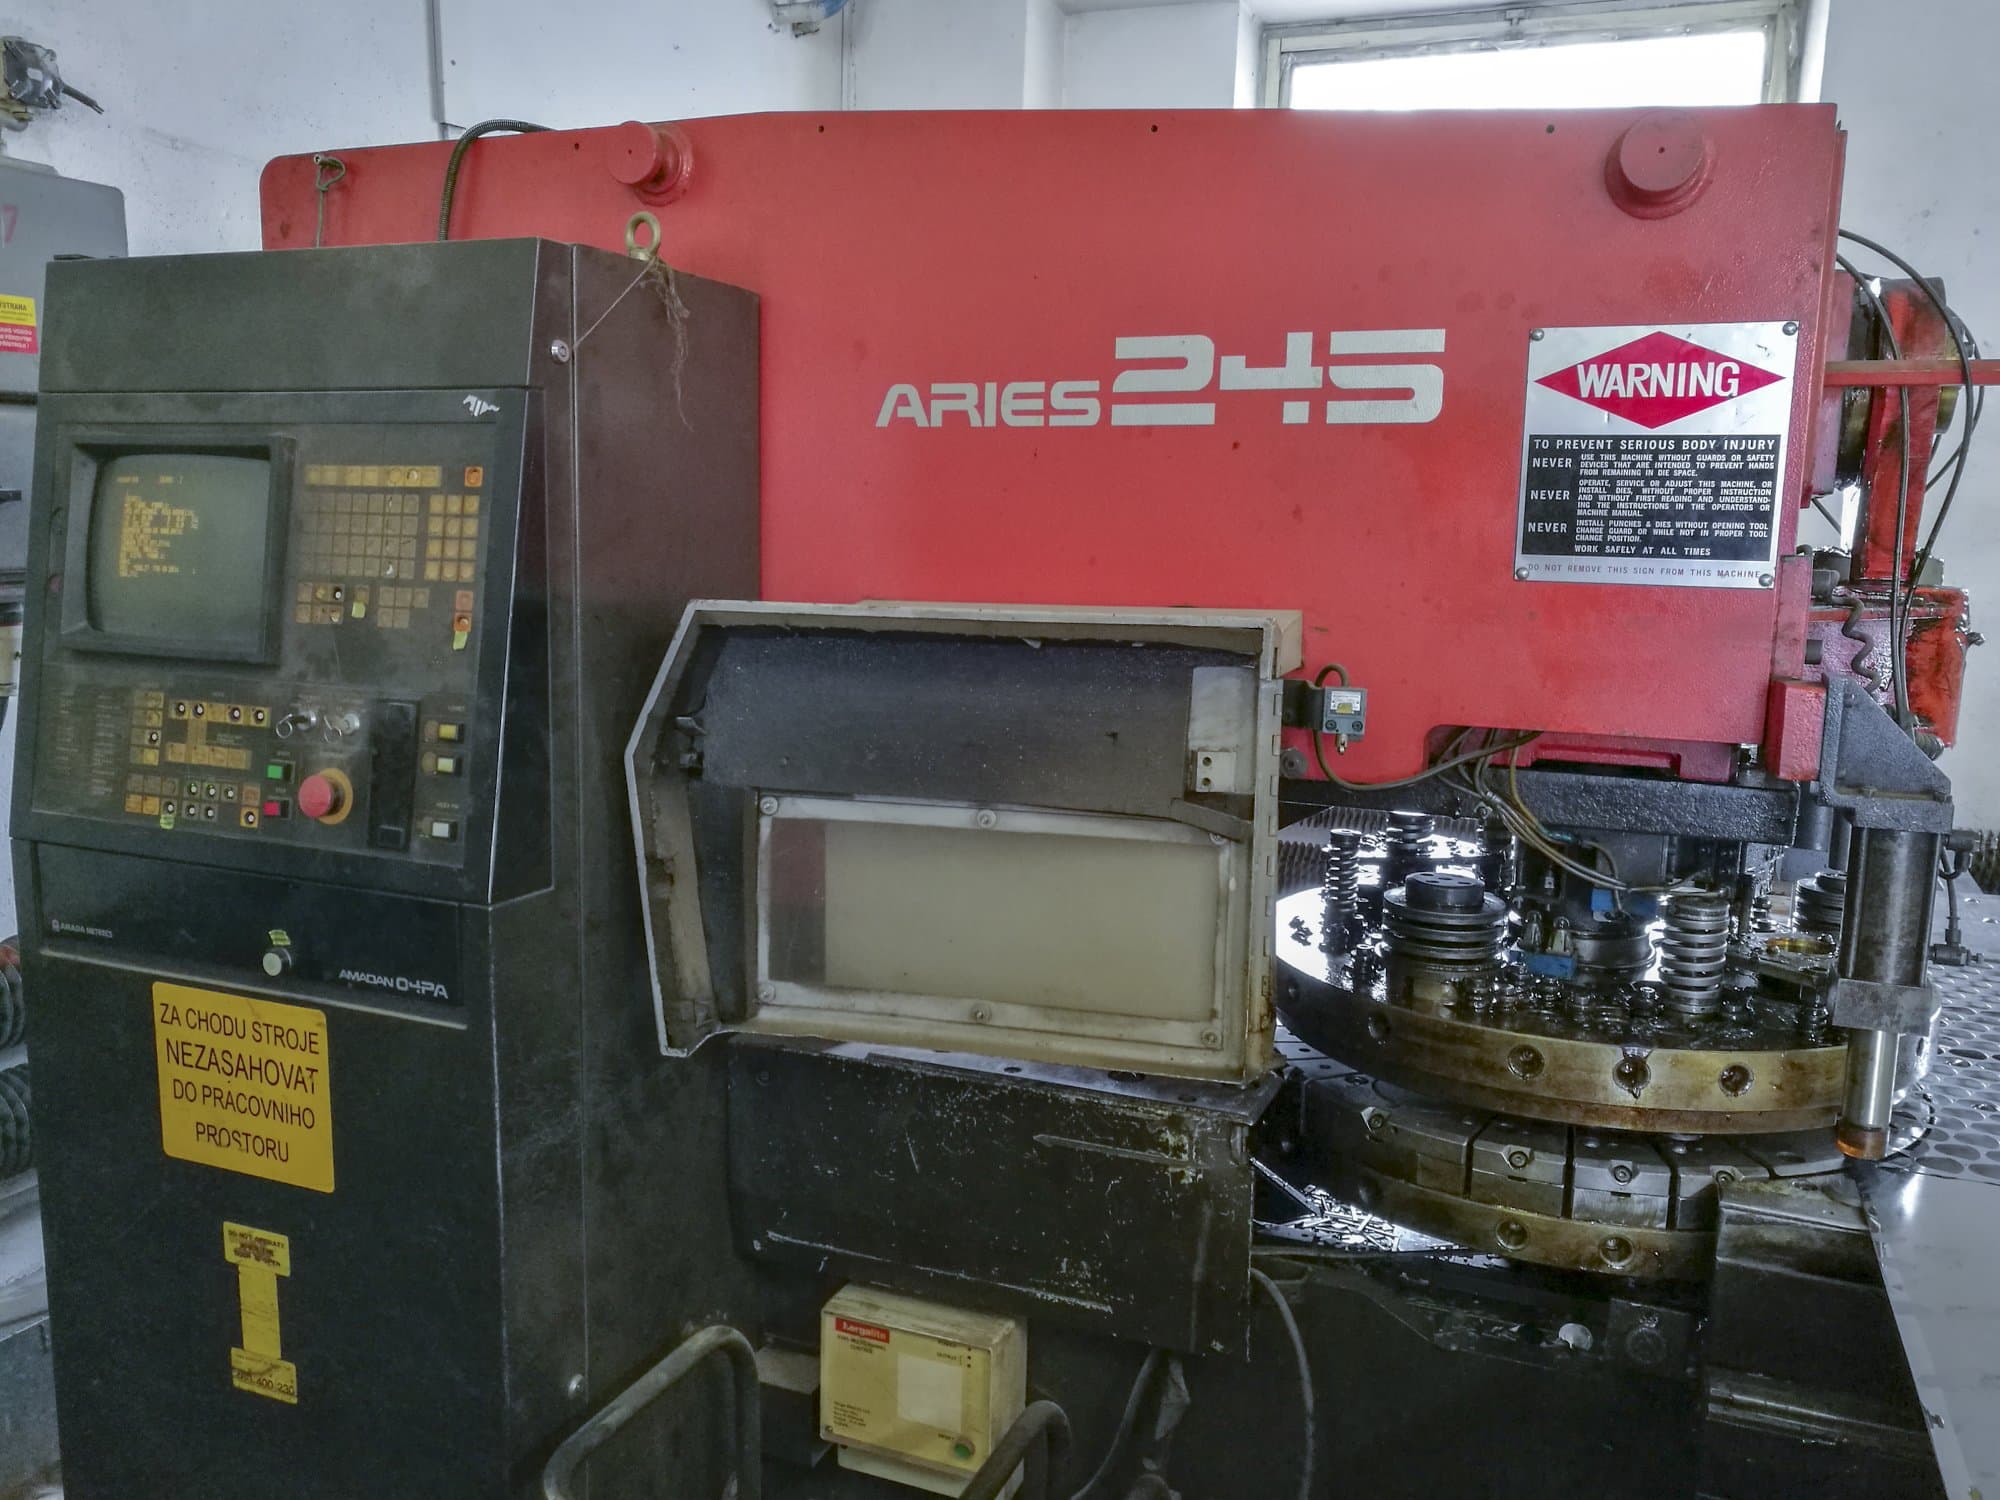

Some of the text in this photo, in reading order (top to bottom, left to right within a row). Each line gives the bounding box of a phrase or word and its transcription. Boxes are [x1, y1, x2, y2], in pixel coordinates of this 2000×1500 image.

[875, 329, 1446, 427] ARIES 245
[1576, 362, 1740, 398] WARNING
[1534, 440, 1775, 450] TO PREVENT SERIOUS BODY INJURY
[1532, 458, 1572, 468] NEVER
[1530, 490, 1570, 500] NEVER
[1616, 487, 1633, 495] DIES,
[1617, 502, 1669, 510] INSTRUCTIONS
[1528, 522, 1567, 533] NEVER
[1675, 521, 1708, 529] WITHOUT
[1575, 544, 1598, 553] WORK
[1605, 545, 1636, 554] SAFELY
[1661, 547, 1677, 555] ALL
[1684, 547, 1710, 555] TIMES
[1568, 565, 1601, 573] REMOVE
[1608, 566, 1628, 574] THIS
[1661, 568, 1684, 576] FROM
[1691, 569, 1712, 577] THIS
[1717, 570, 1760, 578] MACHINE
[339, 969, 449, 1000] AMADAN 04PA
[160, 1003, 320, 1055] ZA CHODU STROJE
[166, 1038, 319, 1095] NEZASAHOVAT
[173, 1079, 315, 1129] DO PRACOVNIHO
[196, 1122, 289, 1162] PROSTORU
